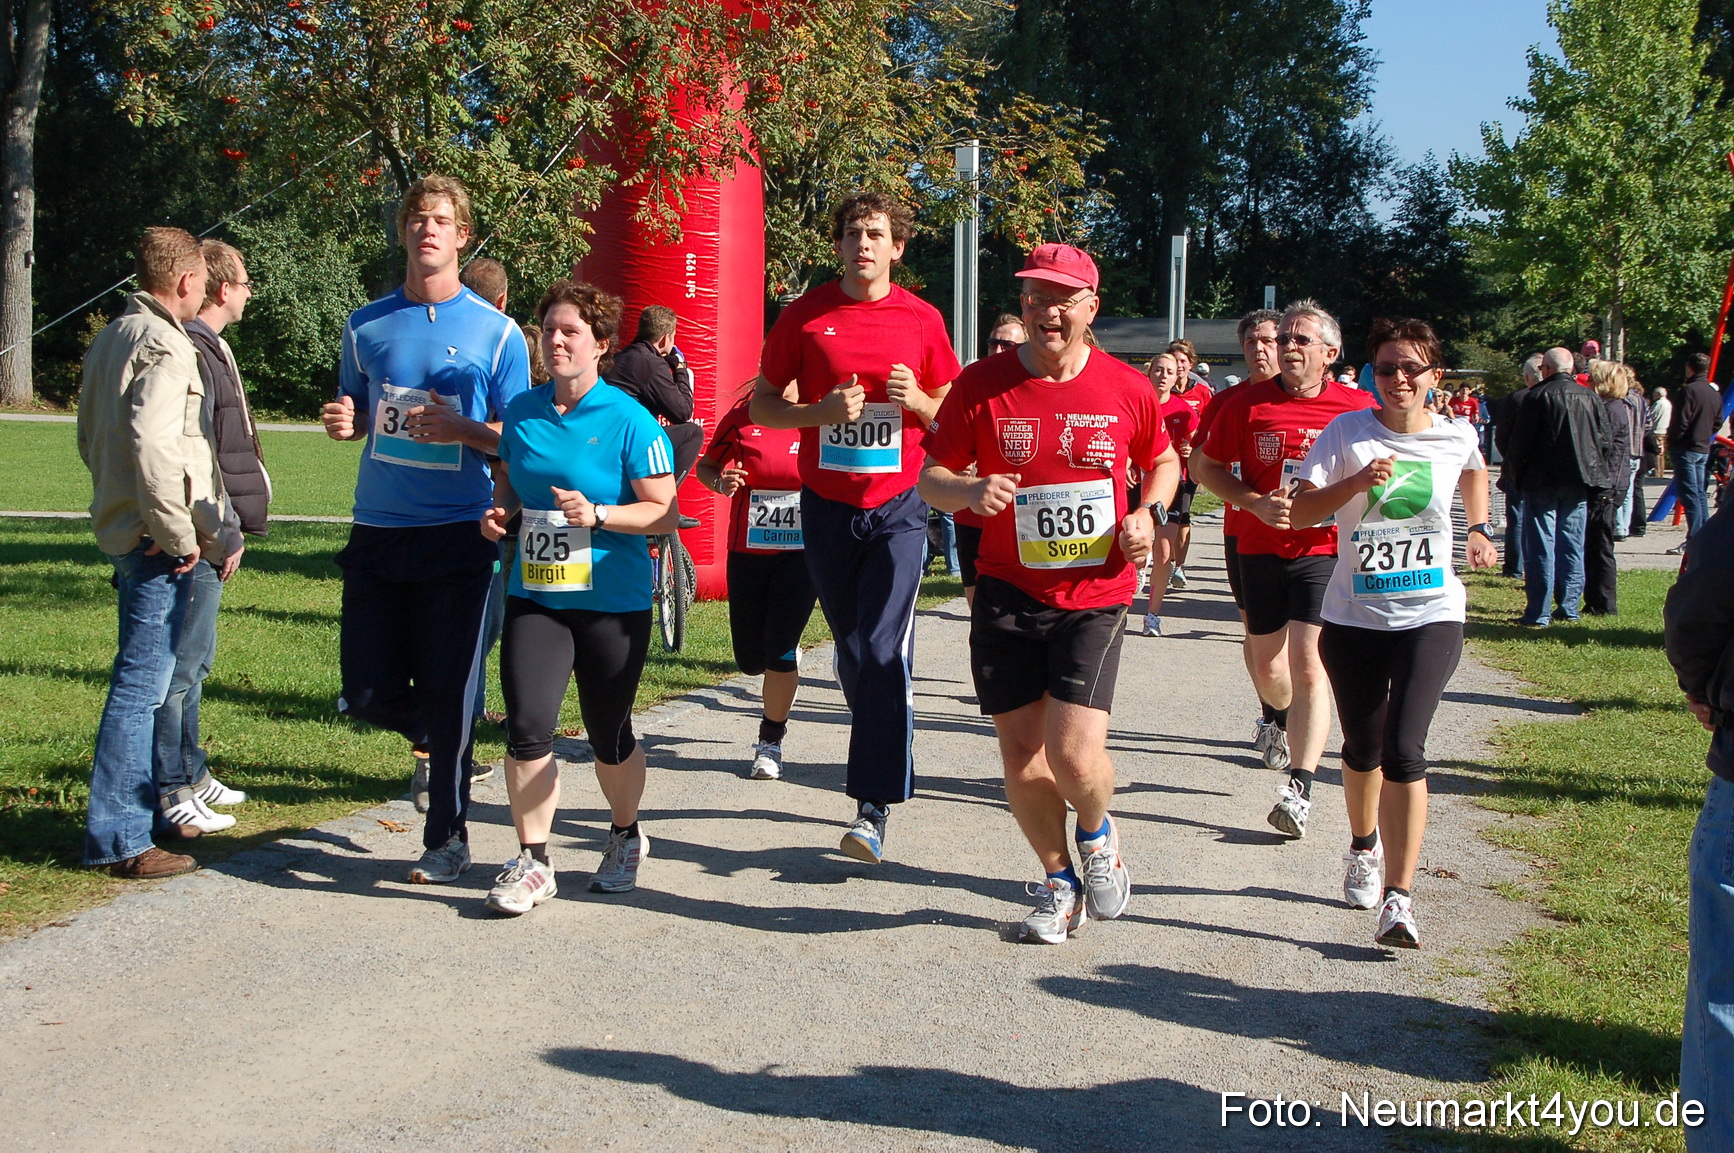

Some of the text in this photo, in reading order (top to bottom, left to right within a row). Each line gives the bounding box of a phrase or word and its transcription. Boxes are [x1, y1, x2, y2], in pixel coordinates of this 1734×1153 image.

[685, 253, 697, 277] 1929
[389, 392, 427, 404] PFLEIDERER
[1065, 420, 1109, 428] STADTLAUF
[1067, 413, 1119, 423] NEUMARKTER
[828, 421, 892, 447] 3500
[1003, 424, 1033, 432] IMMER
[1002, 432, 1034, 440] WIEDER
[1004, 439, 1032, 450] NEU
[1005, 450, 1032, 458] MARKT
[1259, 447, 1279, 456] NEU
[1028, 491, 1071, 501] PFLEIDERER
[755, 505, 801, 528] 244
[1037, 504, 1095, 538] 636
[763, 529, 800, 542] Carina
[1360, 526, 1401, 538] PFLEIDERER
[525, 531, 571, 562] 425
[1047, 540, 1089, 557] Sven
[1358, 537, 1434, 573] 2374
[528, 563, 566, 584] Birgit
[1364, 570, 1432, 590] Cornelia
